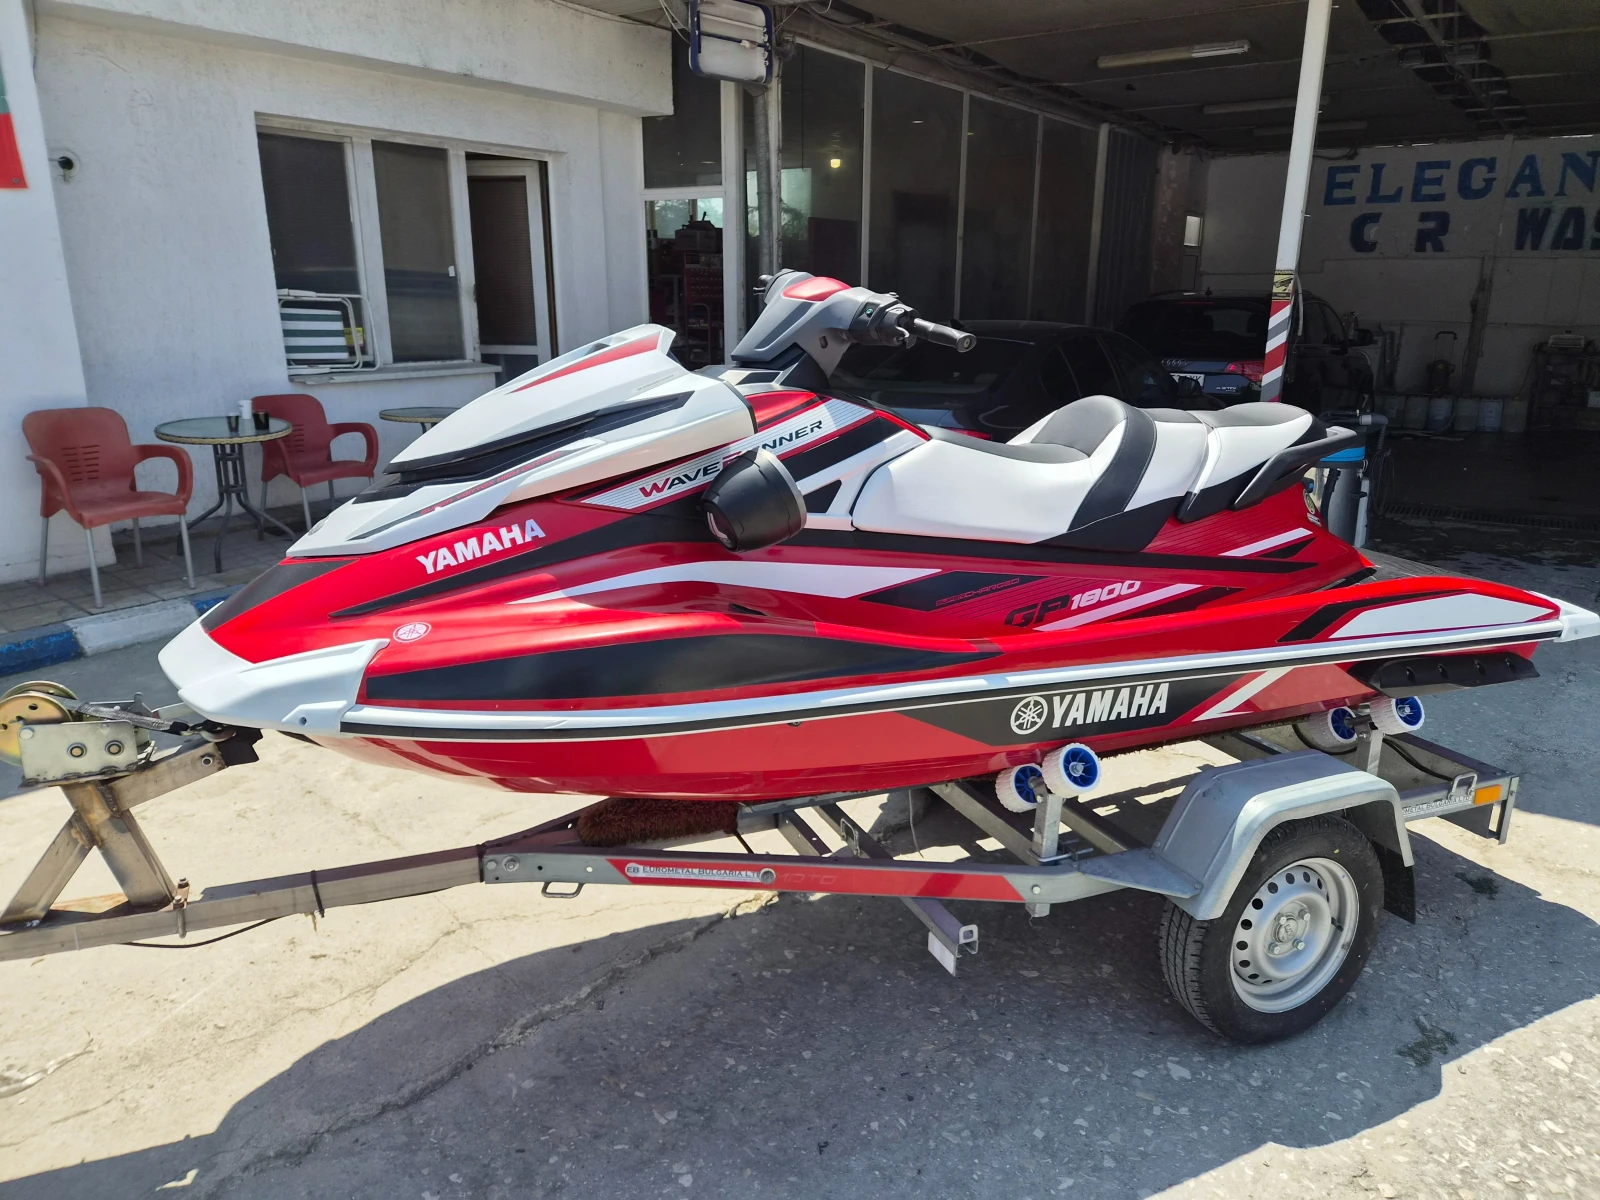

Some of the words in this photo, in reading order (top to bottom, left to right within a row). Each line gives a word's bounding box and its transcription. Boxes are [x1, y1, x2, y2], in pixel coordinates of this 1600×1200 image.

[1323, 150, 1600, 206] ELEGAN
[497, 470, 520, 482] HIGH
[416, 519, 546, 575] YAMAHA
[1052, 683, 1170, 728] YAMAHA
[626, 866, 640, 874] EB
[642, 865, 697, 875] EUROMETAL
[698, 867, 743, 877] BULGARIA
